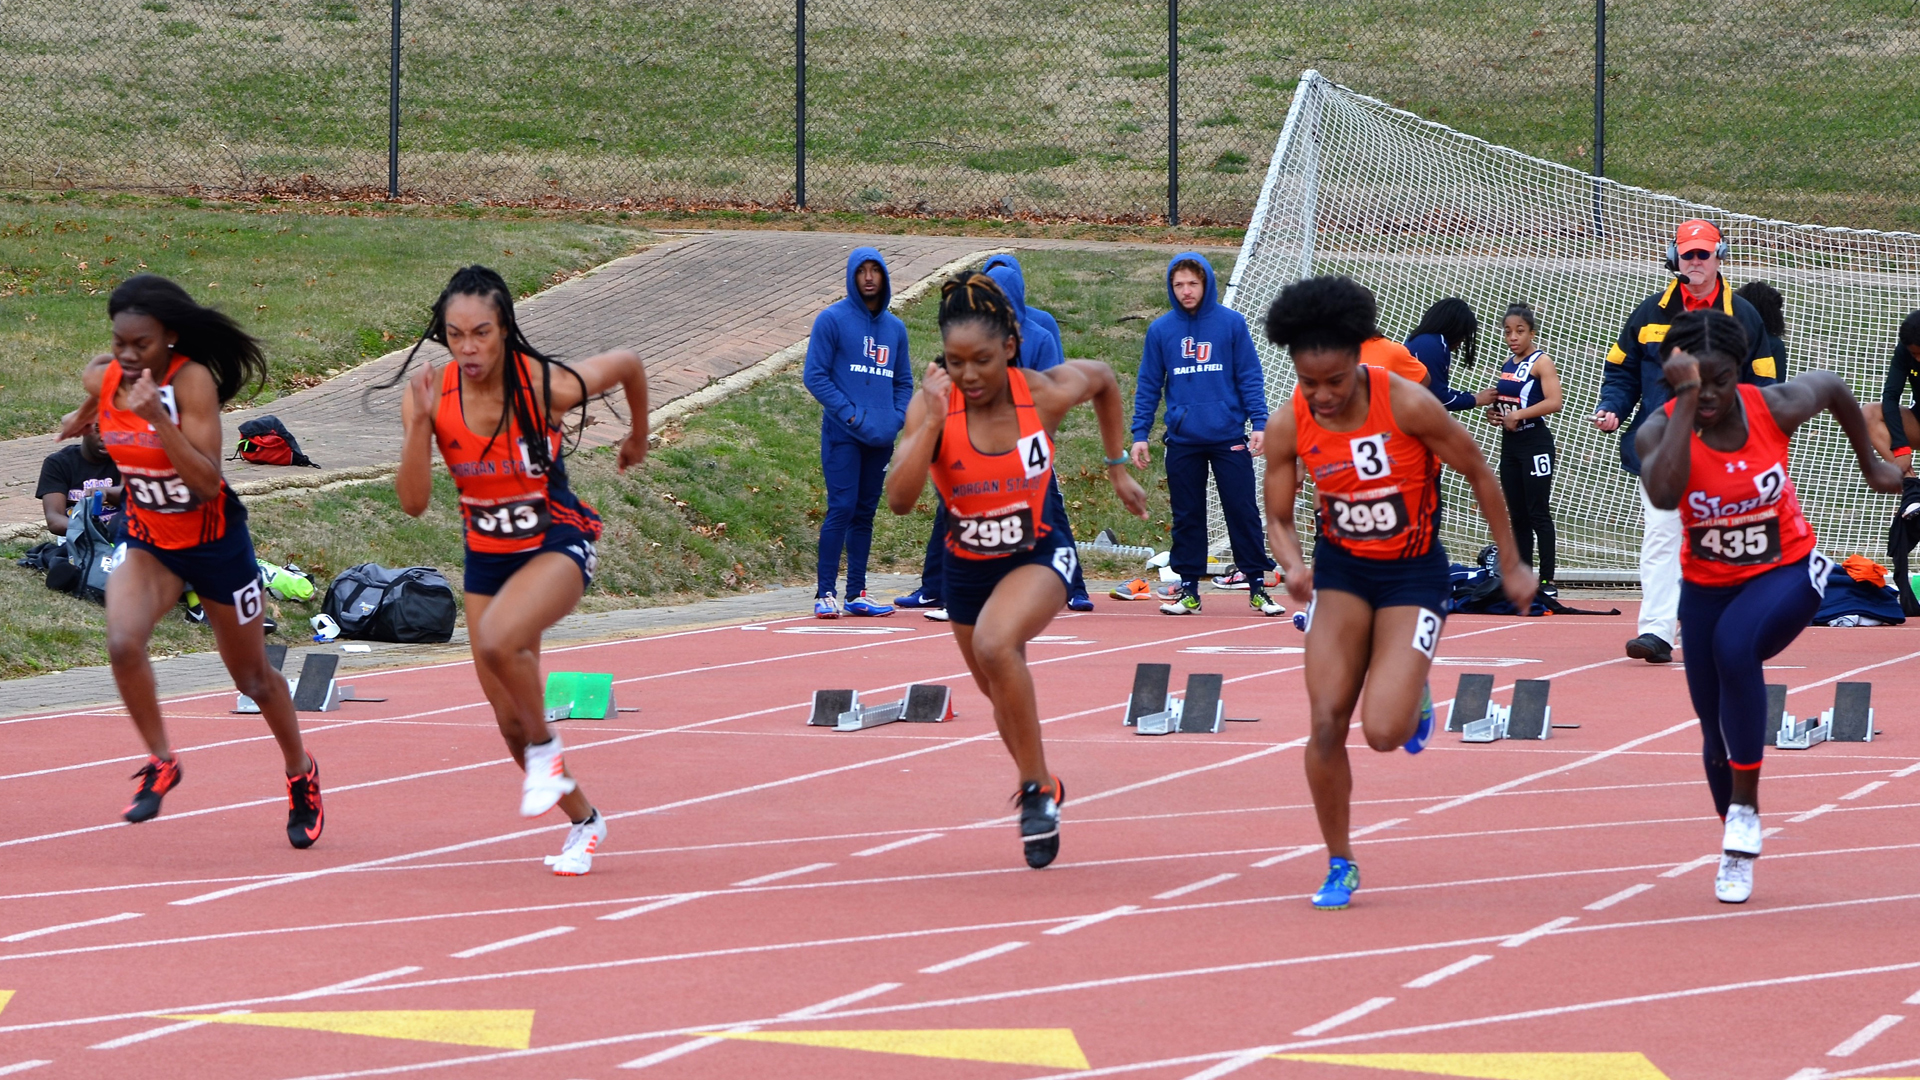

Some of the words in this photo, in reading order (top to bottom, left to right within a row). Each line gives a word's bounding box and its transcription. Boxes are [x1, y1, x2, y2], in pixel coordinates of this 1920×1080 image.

[863, 335, 890, 368] LU
[1181, 336, 1213, 364] LU
[1517, 362, 1530, 379] 6
[501, 460, 525, 475] STA
[1028, 436, 1048, 471] 4
[1357, 440, 1384, 477] 3
[1537, 455, 1549, 475] 6
[129, 477, 191, 506] 315
[952, 479, 999, 498] MORGAN
[1761, 471, 1782, 502] 2
[959, 515, 1023, 547] 298
[1333, 501, 1398, 533] 299
[1730, 507, 1777, 527] INVITATIONAL
[1700, 524, 1769, 558] 435
[240, 586, 259, 619] 6
[1419, 615, 1437, 652] 3
